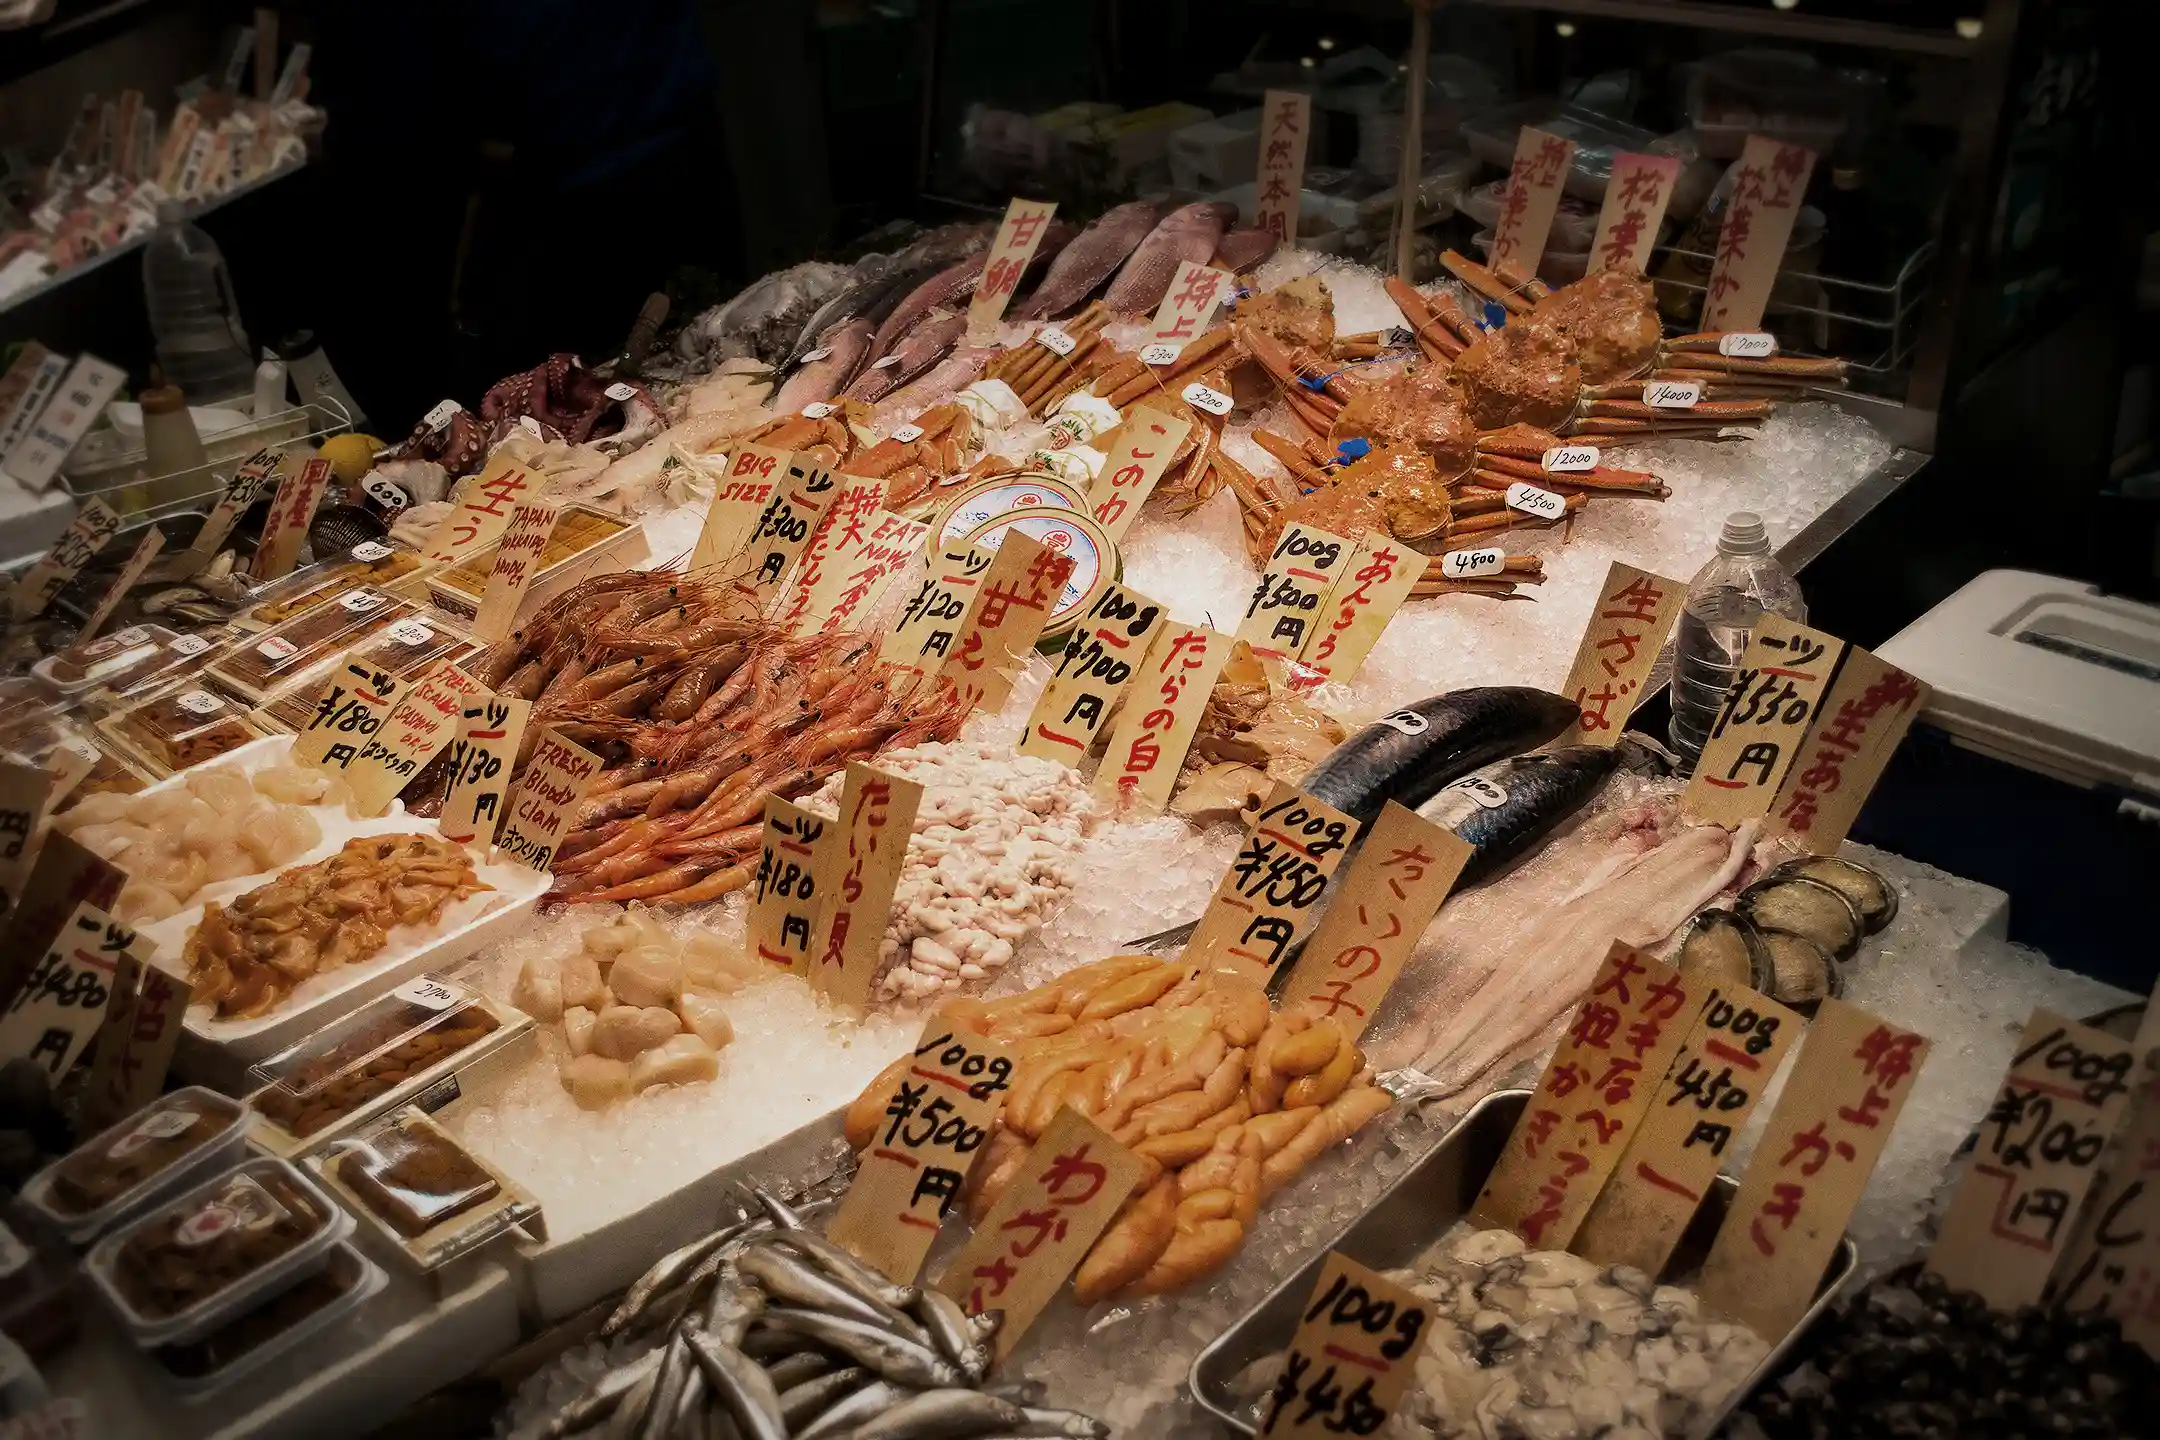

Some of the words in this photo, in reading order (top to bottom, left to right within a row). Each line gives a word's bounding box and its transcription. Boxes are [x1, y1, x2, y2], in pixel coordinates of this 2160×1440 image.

[1492, 156, 1537, 273] 松葉か
[1601, 167, 1665, 268] 松葉
[1156, 267, 1223, 341] 特上
[1197, 387, 1224, 409] 3200
[1649, 383, 1693, 402] 14000
[732, 452, 778, 479] BIG
[1549, 448, 1591, 466] 12000
[370, 481, 402, 506] 600
[431, 469, 527, 561] 生う
[719, 481, 773, 504] SIZE
[1519, 487, 1556, 511] 4500
[512, 505, 557, 532] JAPAN
[751, 495, 808, 545] ¥300
[870, 517, 928, 544] EAT
[756, 551, 786, 585] 円
[1272, 528, 1342, 570] 100g
[1455, 551, 1496, 574] 4800
[896, 579, 965, 632] ¥120
[1087, 585, 1159, 636] 100g
[1246, 574, 1319, 619] ¥500
[920, 630, 953, 658] 円
[1271, 616, 1305, 648] 円
[1577, 576, 1664, 732] 生さば
[1758, 635, 1824, 667] 一ツ
[1056, 628, 1131, 685] ¥700
[308, 686, 381, 736] ¥180
[463, 703, 509, 729] 一ツ
[1063, 693, 1104, 731] 円
[1711, 668, 1807, 740] ¥550
[321, 742, 358, 769] 円
[445, 738, 502, 802] ¥130
[533, 738, 594, 781] FRESH
[1728, 742, 1780, 786] 円
[472, 792, 499, 825] 円
[525, 767, 577, 807] Bloody
[771, 816, 824, 843] 一ツ
[1258, 797, 1347, 856] 100g
[757, 846, 815, 904] ¥180
[1235, 837, 1328, 909] ¥450
[781, 912, 810, 952] 円
[1240, 915, 1295, 965] 円
[1702, 987, 1780, 1055] 100g
[30, 1027, 74, 1073] 円
[914, 1033, 1013, 1100] 100g
[2010, 1027, 2133, 1101] 100g
[1664, 1046, 1749, 1112] 450
[885, 1081, 987, 1153] ¥500
[1683, 1119, 1732, 1157] 円
[1749, 1024, 1924, 1257] 特上かき
[1988, 1087, 2104, 1169] ¥200
[910, 1166, 963, 1219] 円
[2009, 1188, 2070, 1243] 円
[1305, 1272, 1427, 1361] 100g
[1263, 1351, 1388, 1436] ¥450
